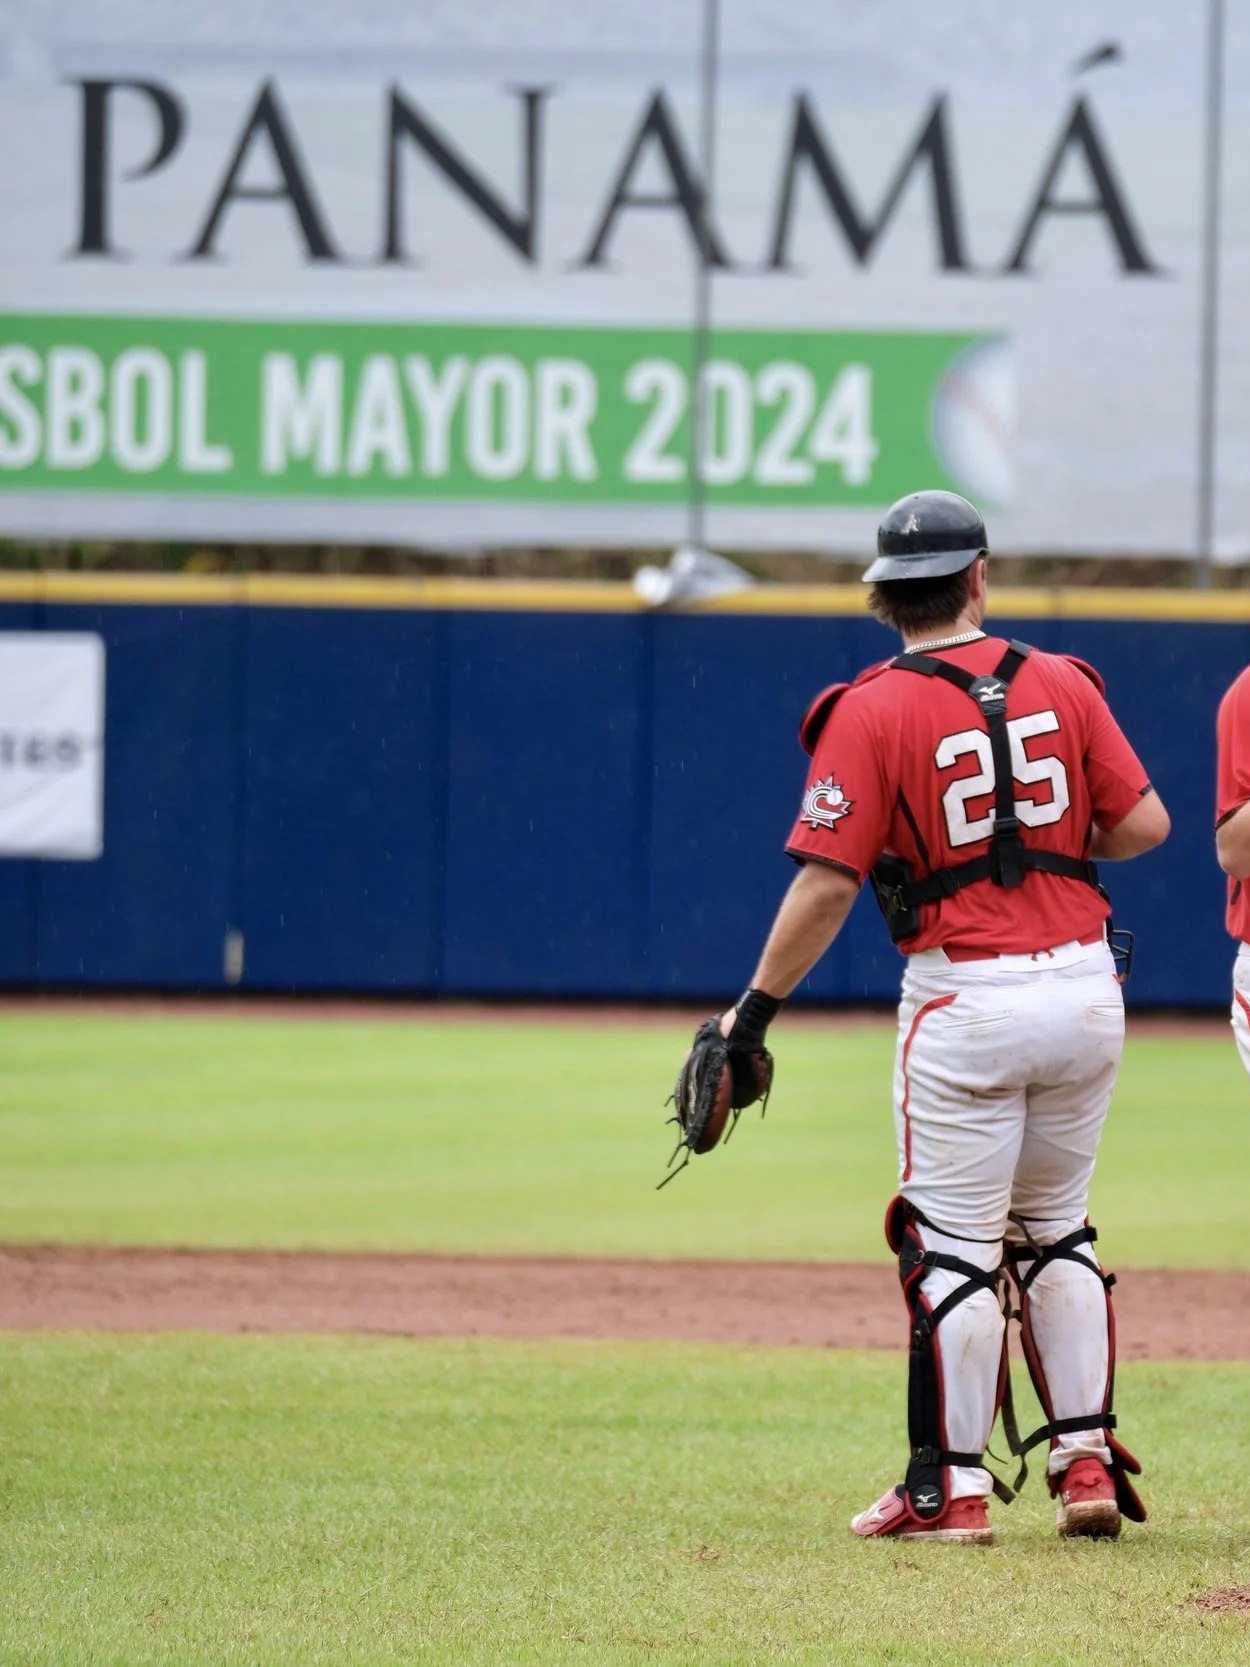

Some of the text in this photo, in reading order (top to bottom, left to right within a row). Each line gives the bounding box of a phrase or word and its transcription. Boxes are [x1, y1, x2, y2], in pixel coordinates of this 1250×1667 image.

[65, 41, 1172, 279] PANAMÁ
[0, 345, 877, 487] SBOL MAYOR 2024
[934, 709, 1070, 847] 25
